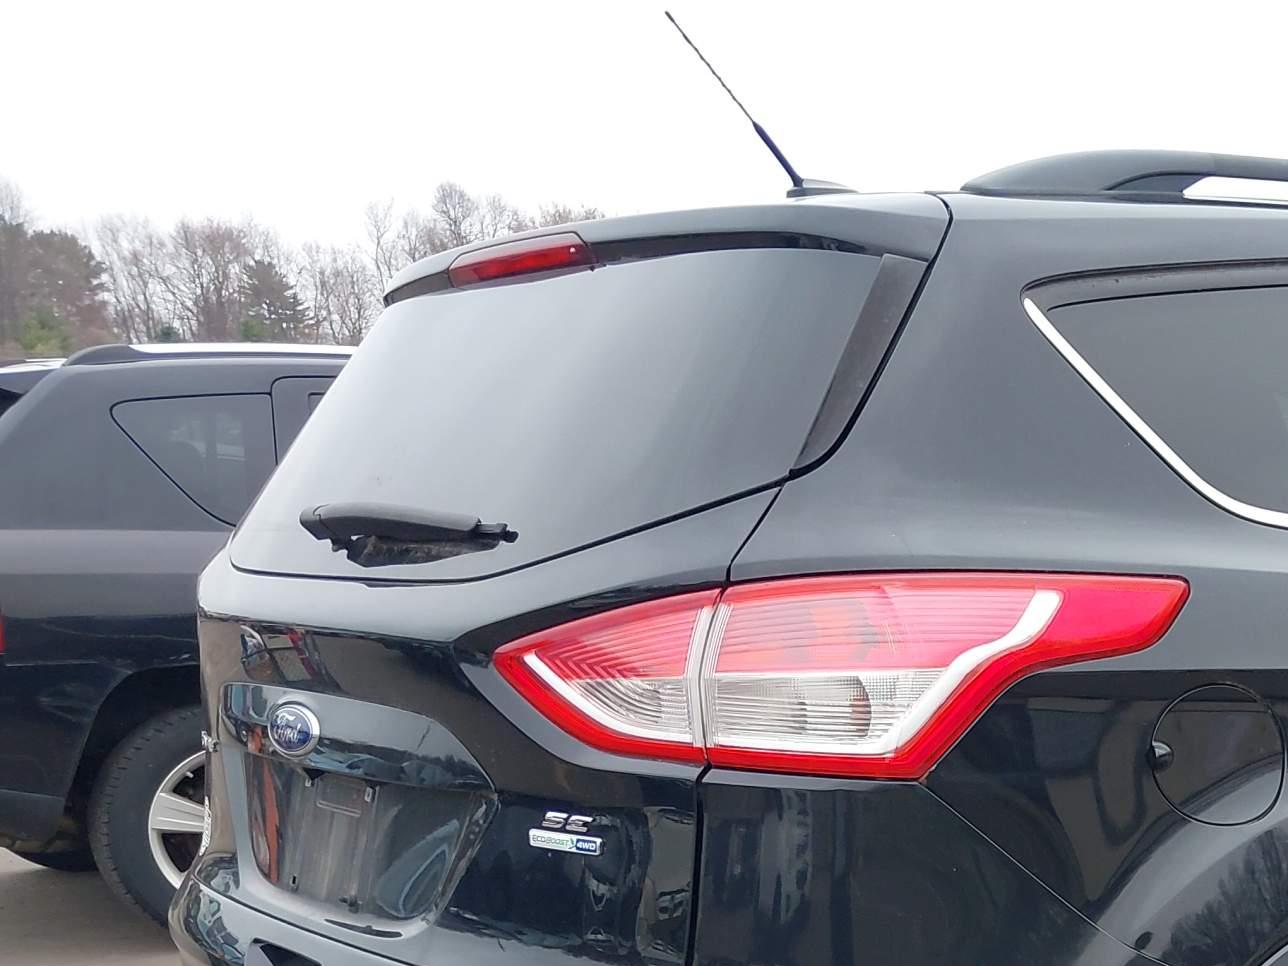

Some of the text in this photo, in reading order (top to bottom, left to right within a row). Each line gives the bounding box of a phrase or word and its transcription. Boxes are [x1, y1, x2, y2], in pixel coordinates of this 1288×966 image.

[273, 713, 302, 743] Ford
[542, 811, 594, 833] SE
[577, 841, 596, 850] 4WD
